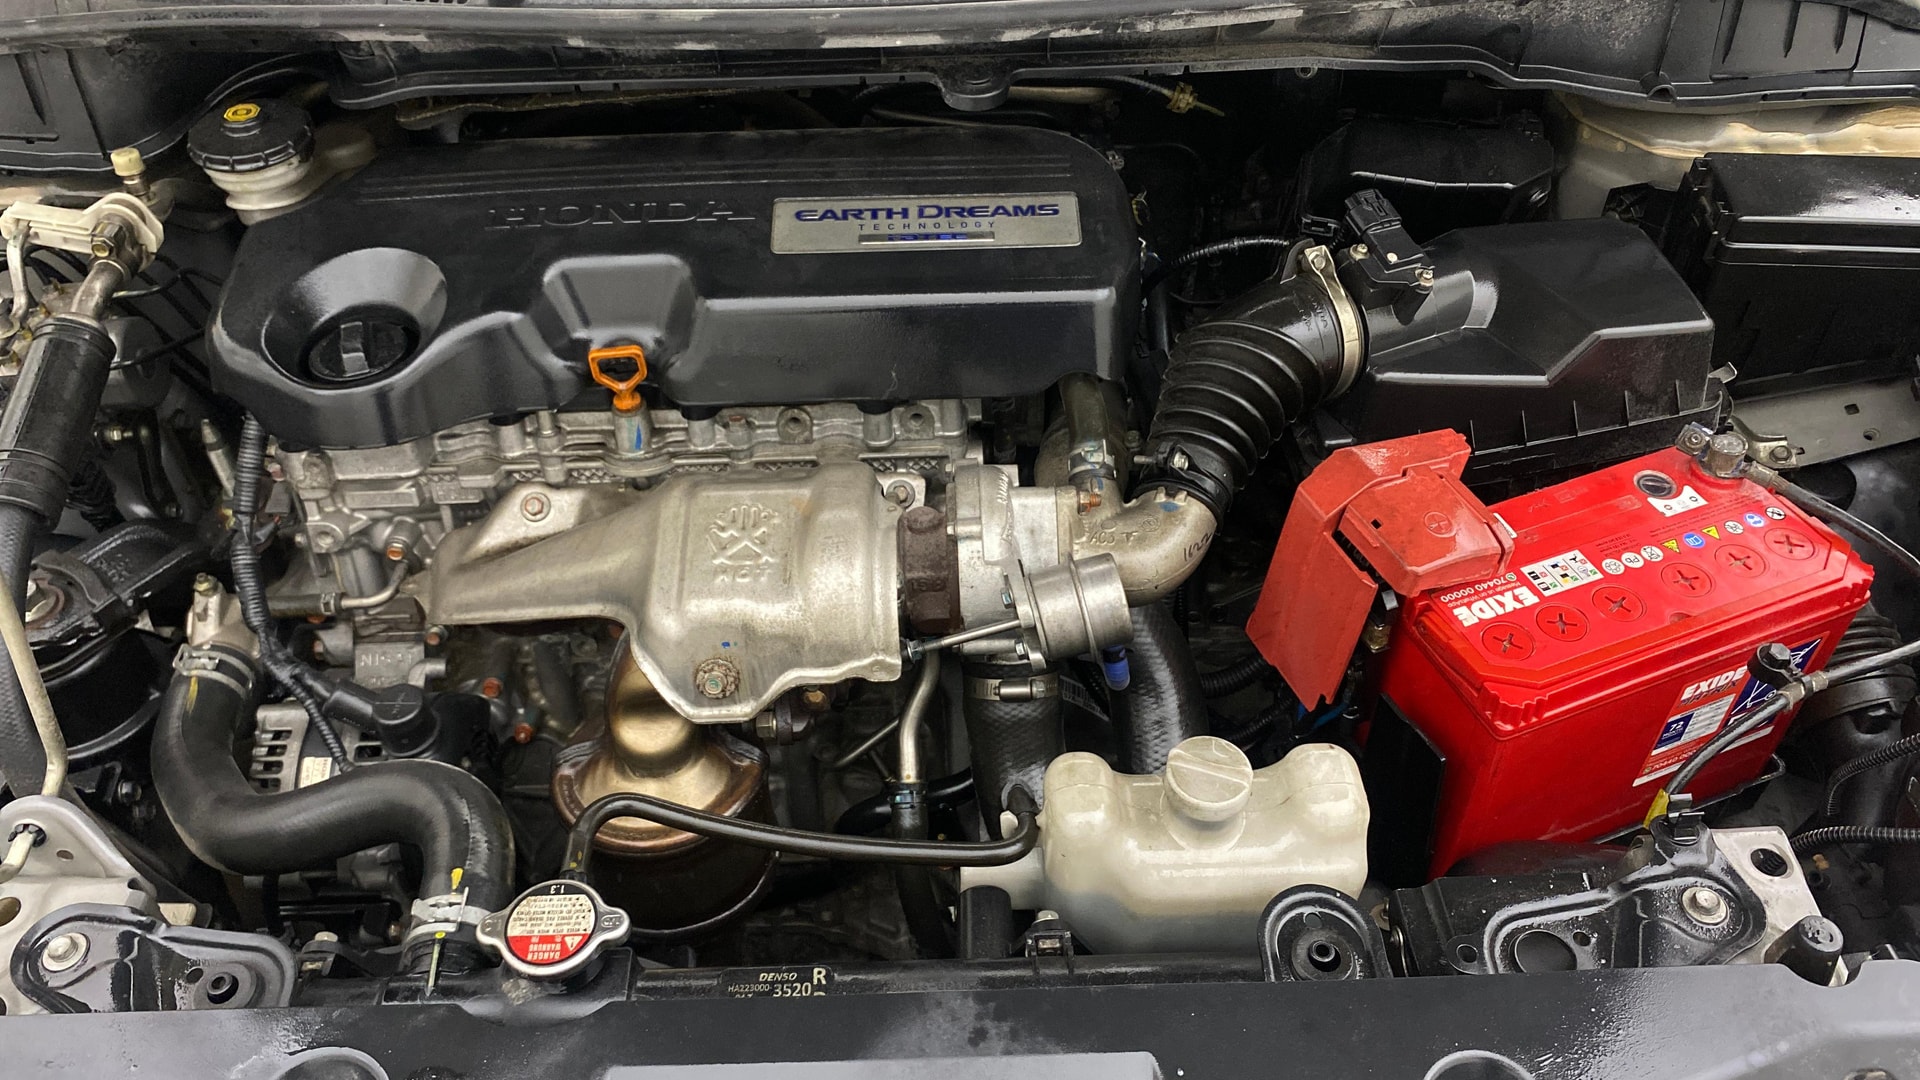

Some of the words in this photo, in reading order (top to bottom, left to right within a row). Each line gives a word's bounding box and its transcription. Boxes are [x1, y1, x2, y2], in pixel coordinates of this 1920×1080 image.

[484, 201, 757, 231] HONDA
[794, 206, 909, 222] EARTH
[917, 203, 1061, 220] DREAMS
[858, 221, 996, 231] TECHNOLOGY
[1475, 576, 1508, 591] 70440
[1440, 586, 1475, 603] 00000
[1452, 585, 1541, 628] EXIDE
[1680, 665, 1748, 701] EXIDE
[1669, 720, 1684, 732] 72
[549, 884, 565, 895] 1.3
[526, 951, 561, 961] DANGER
[759, 972, 798, 982] DENSO
